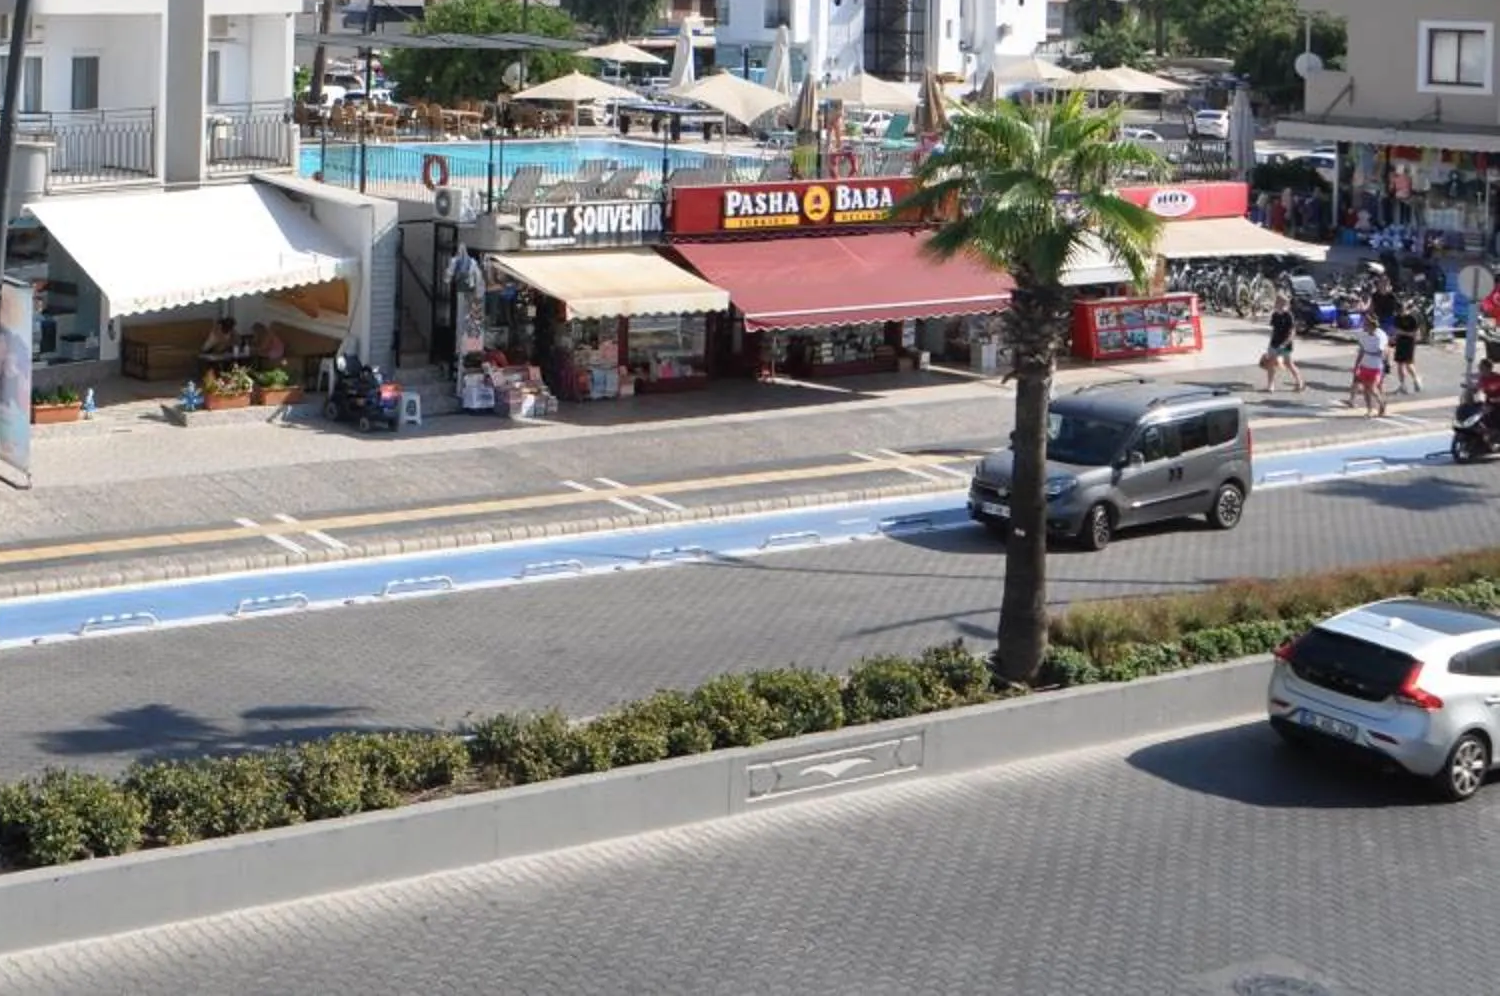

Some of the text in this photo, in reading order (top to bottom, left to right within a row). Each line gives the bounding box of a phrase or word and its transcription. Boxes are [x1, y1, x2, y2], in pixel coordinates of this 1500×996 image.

[725, 185, 893, 216] PASHA BABA
[525, 203, 663, 237] GIFT SOUVENIR
